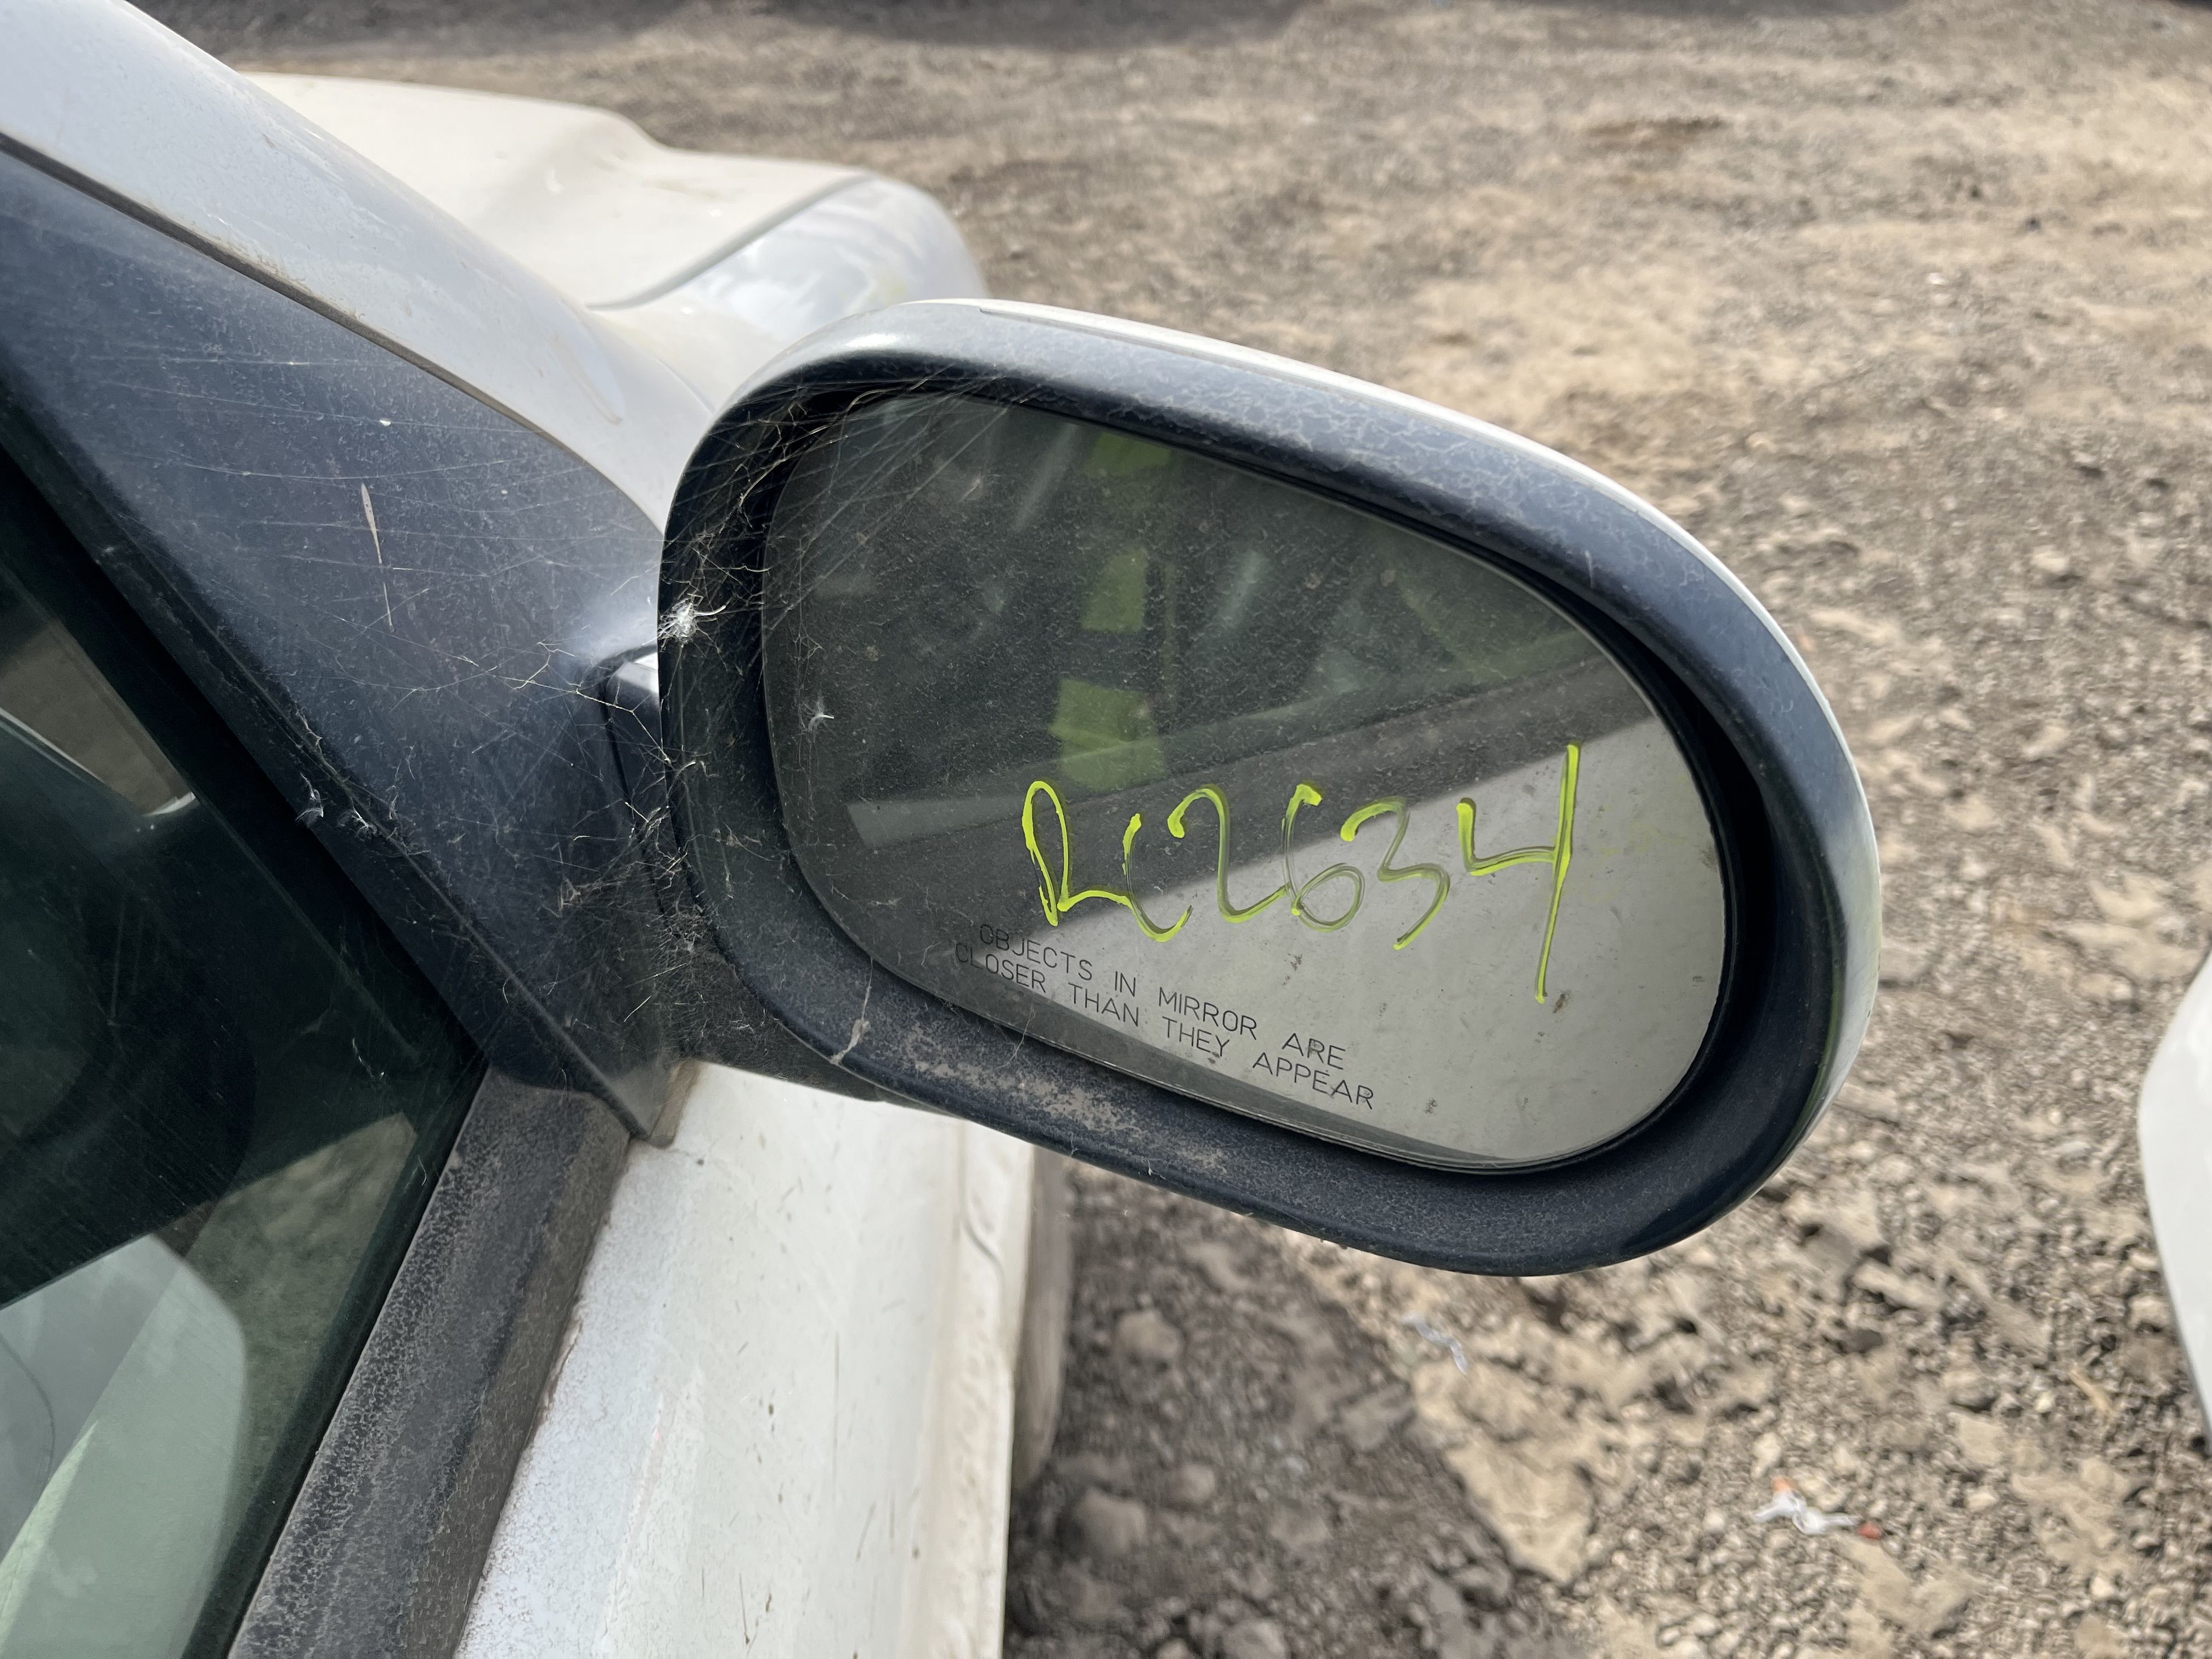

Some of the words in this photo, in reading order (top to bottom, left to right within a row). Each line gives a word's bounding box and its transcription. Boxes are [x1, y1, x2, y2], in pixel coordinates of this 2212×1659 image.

[955, 943, 1046, 993] CLOSER
[1068, 982, 1139, 1026] THAN
[1161, 1015, 1230, 1057] THEY
[1252, 1052, 1374, 1110] APPEAR
[979, 923, 1093, 981] OBJECTS
[1114, 970, 1136, 997] IN
[1158, 986, 1257, 1040] MIRROR
[1281, 1032, 1346, 1070] ARE
